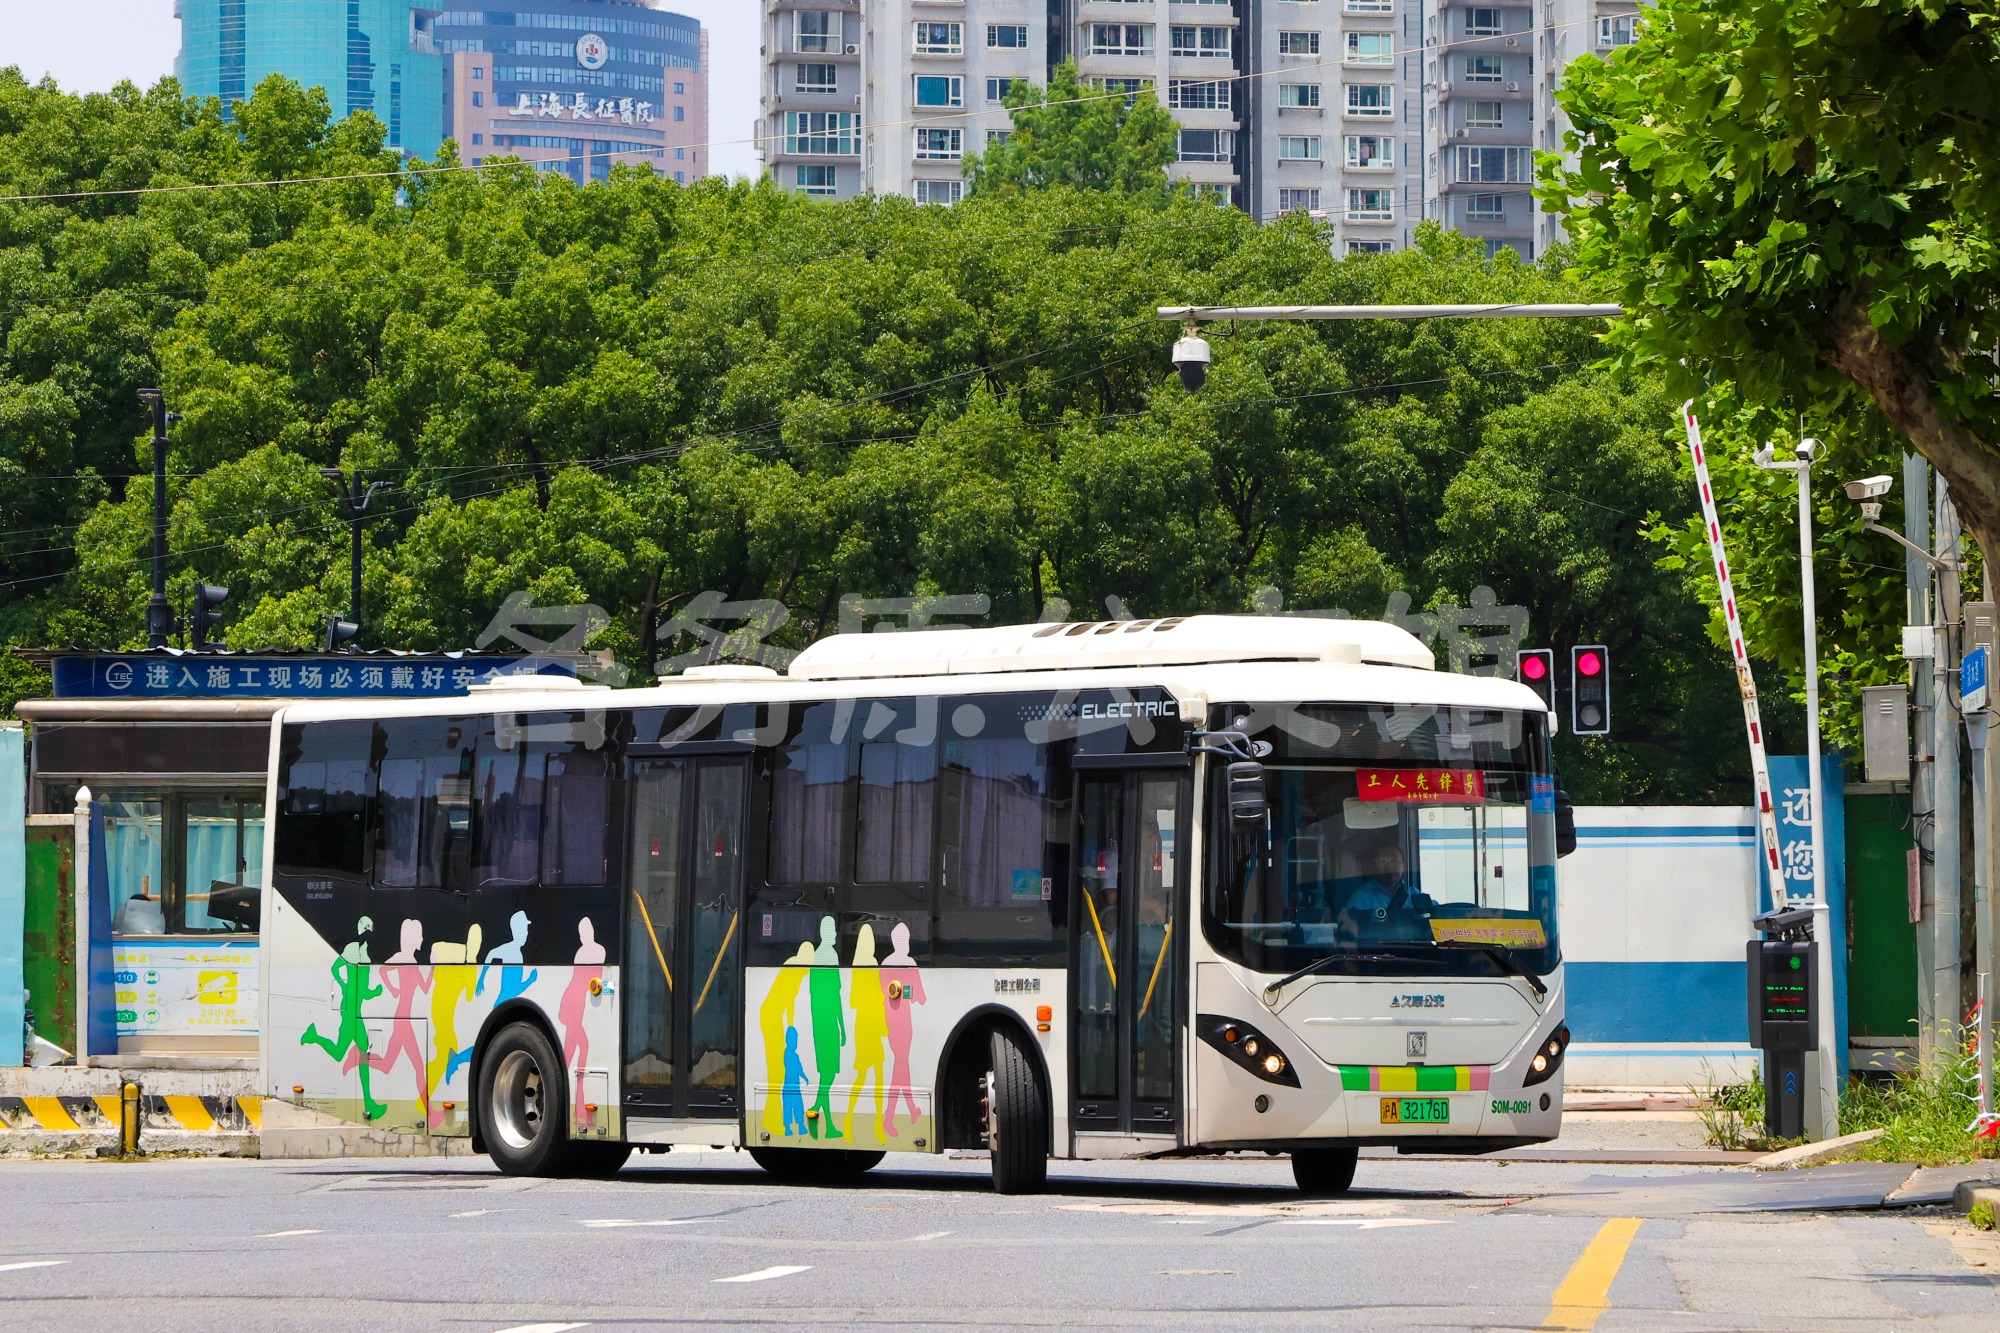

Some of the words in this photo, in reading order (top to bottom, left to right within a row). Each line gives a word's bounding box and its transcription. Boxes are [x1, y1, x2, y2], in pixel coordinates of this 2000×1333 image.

[1081, 699, 1176, 720] ELECTRIC
[1367, 772, 1475, 795] 工人先锋号
[116, 974, 134, 982] 110
[116, 1012, 133, 1021] 120
